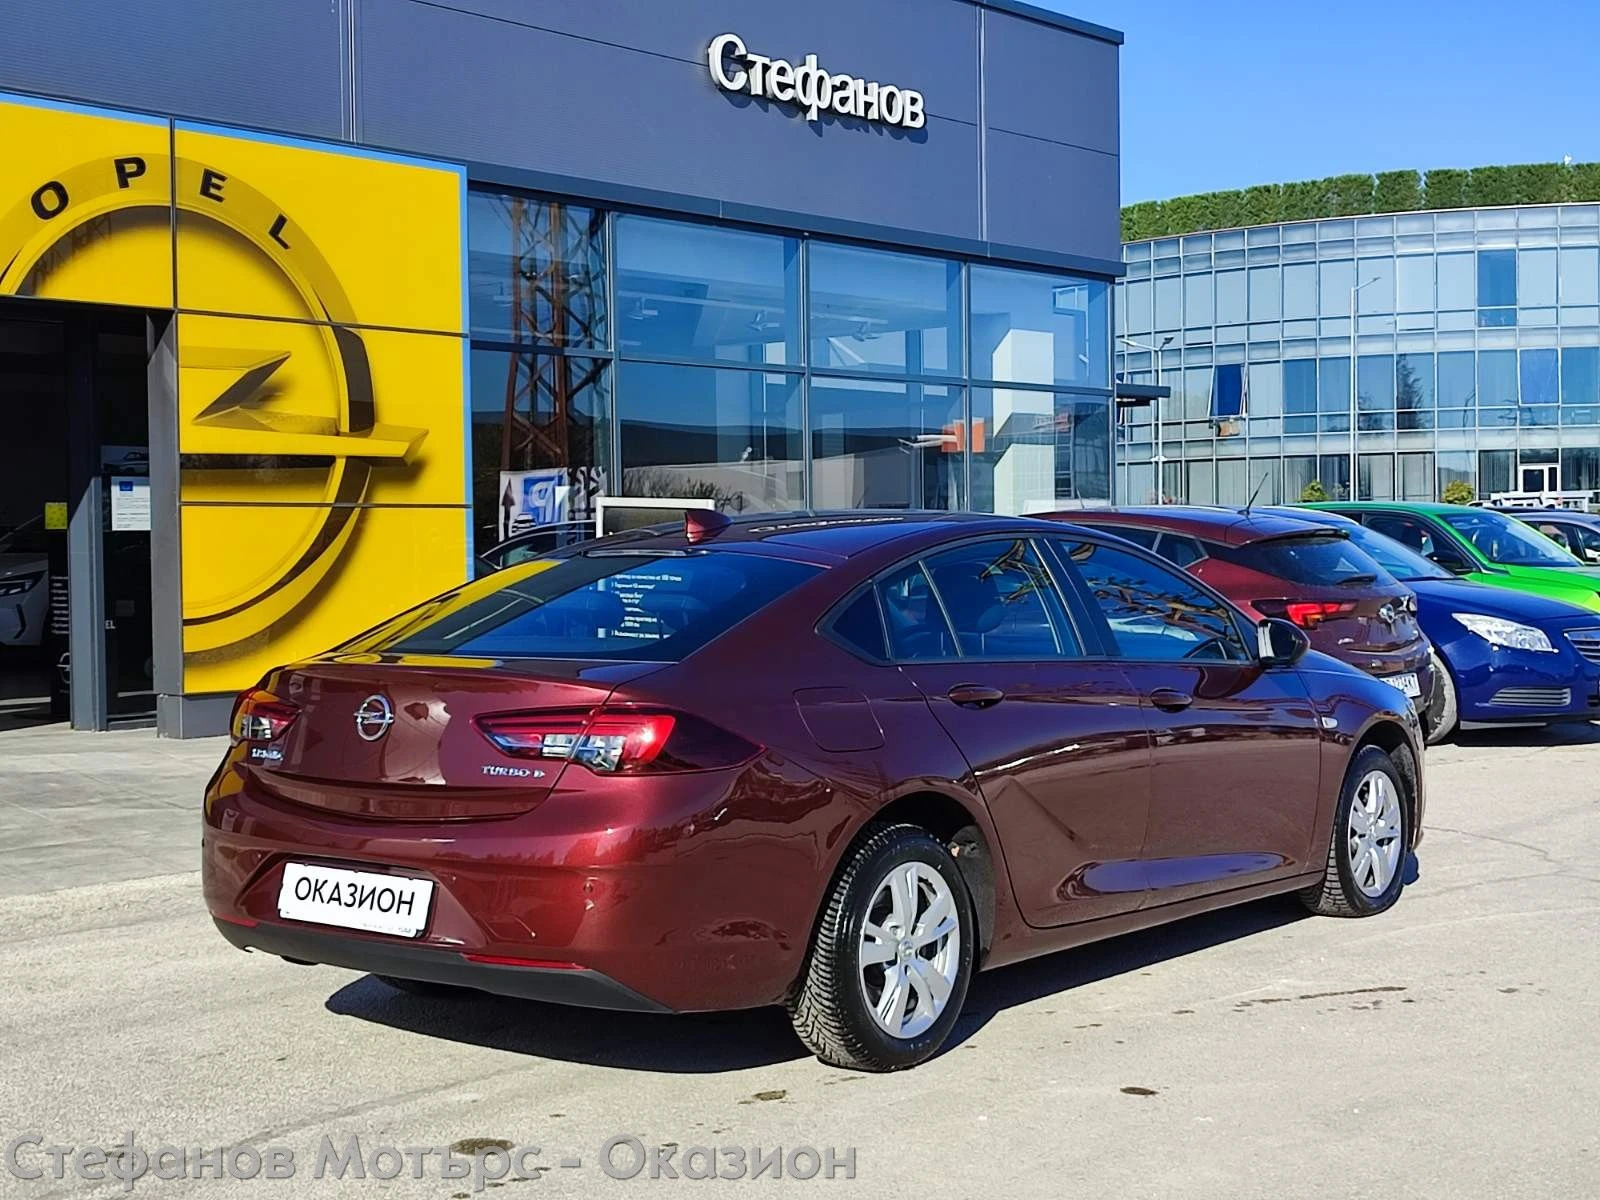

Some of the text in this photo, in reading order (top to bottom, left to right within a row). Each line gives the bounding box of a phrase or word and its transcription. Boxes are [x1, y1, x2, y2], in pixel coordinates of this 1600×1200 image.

[708, 33, 925, 128] Стефанов
[31, 156, 291, 250] OPEL
[482, 765, 530, 777] TURBO
[295, 876, 415, 916] ОКАЗИОН
